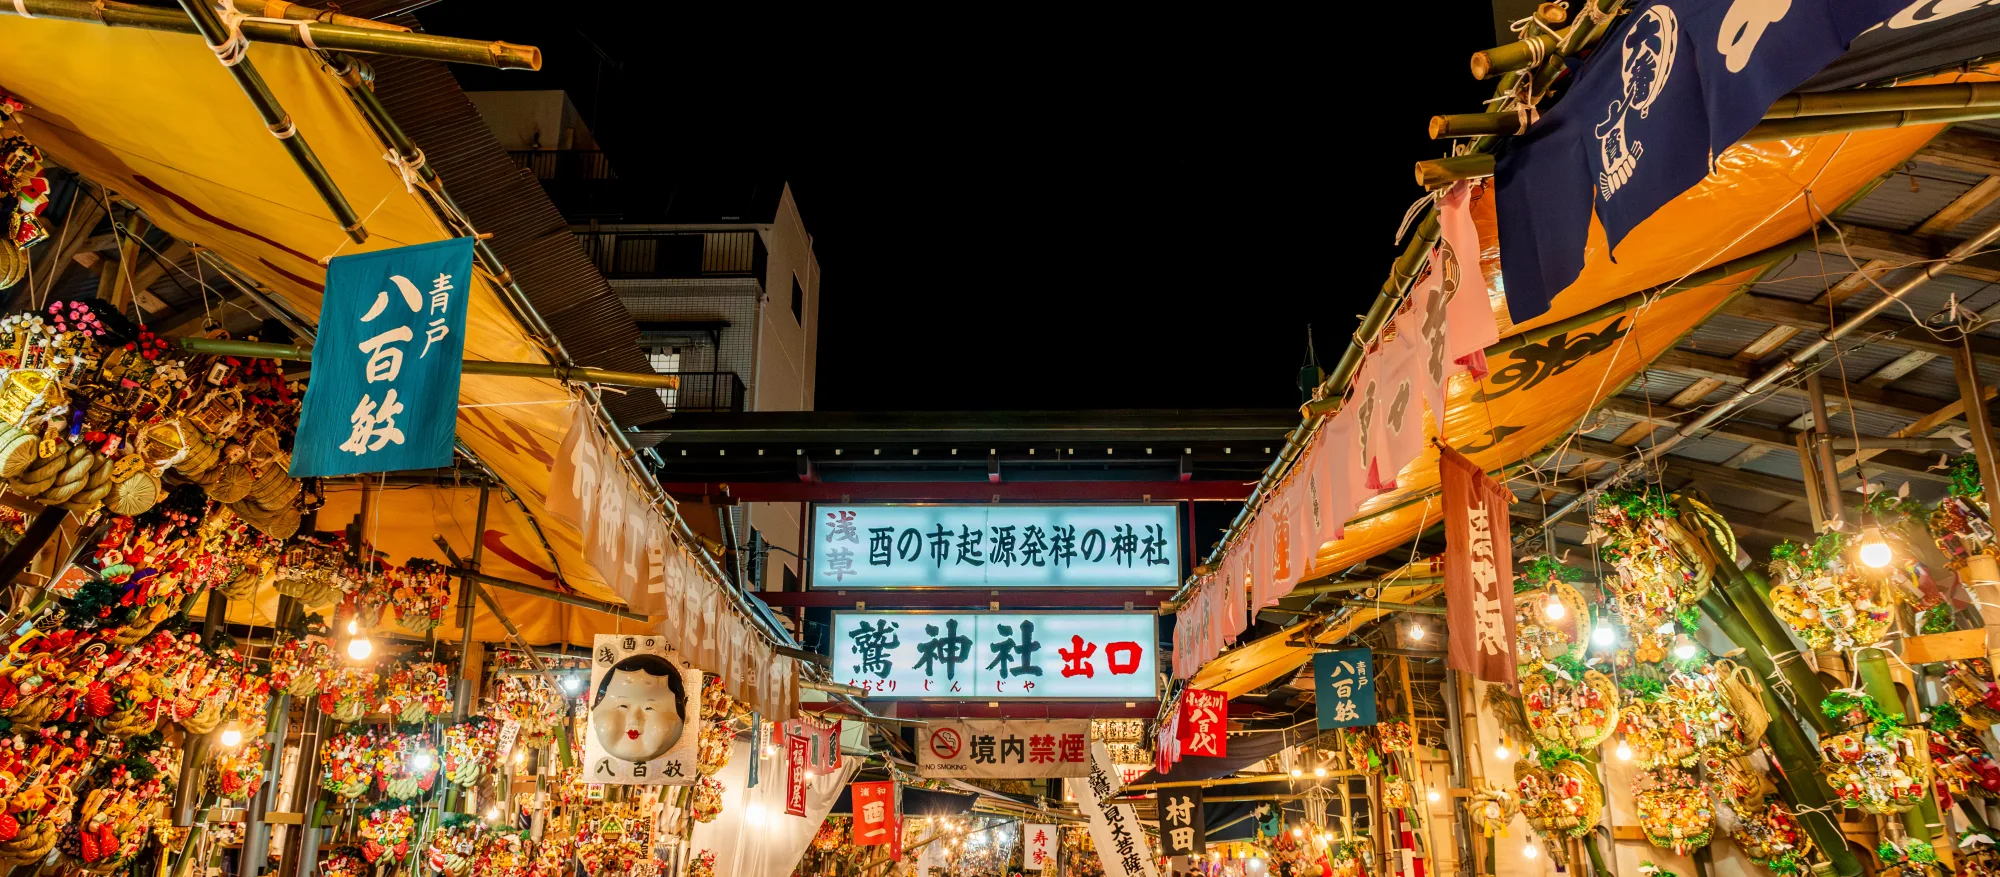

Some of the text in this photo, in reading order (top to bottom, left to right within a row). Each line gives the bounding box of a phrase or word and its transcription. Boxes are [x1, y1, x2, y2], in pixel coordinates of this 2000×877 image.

[419, 272, 454, 360] 青戸
[338, 275, 424, 456] 八百敏
[824, 510, 859, 582] 浅草
[868, 523, 1171, 570] 酉の市起源発祥の神社
[848, 618, 1044, 681] 鷲神社
[1057, 634, 1144, 680] 出口
[1330, 660, 1360, 723] 八百敏
[1356, 660, 1369, 691] 青戸
[1185, 691, 1225, 712] 小松川
[969, 733, 1086, 764] 境内禁煙
[1188, 708, 1219, 756] 八百代
[596, 758, 685, 778] 八百敏
[925, 763, 968, 771] NO SMOKING
[1165, 795, 1196, 852] 村田
[1032, 829, 1049, 866] 寿家
